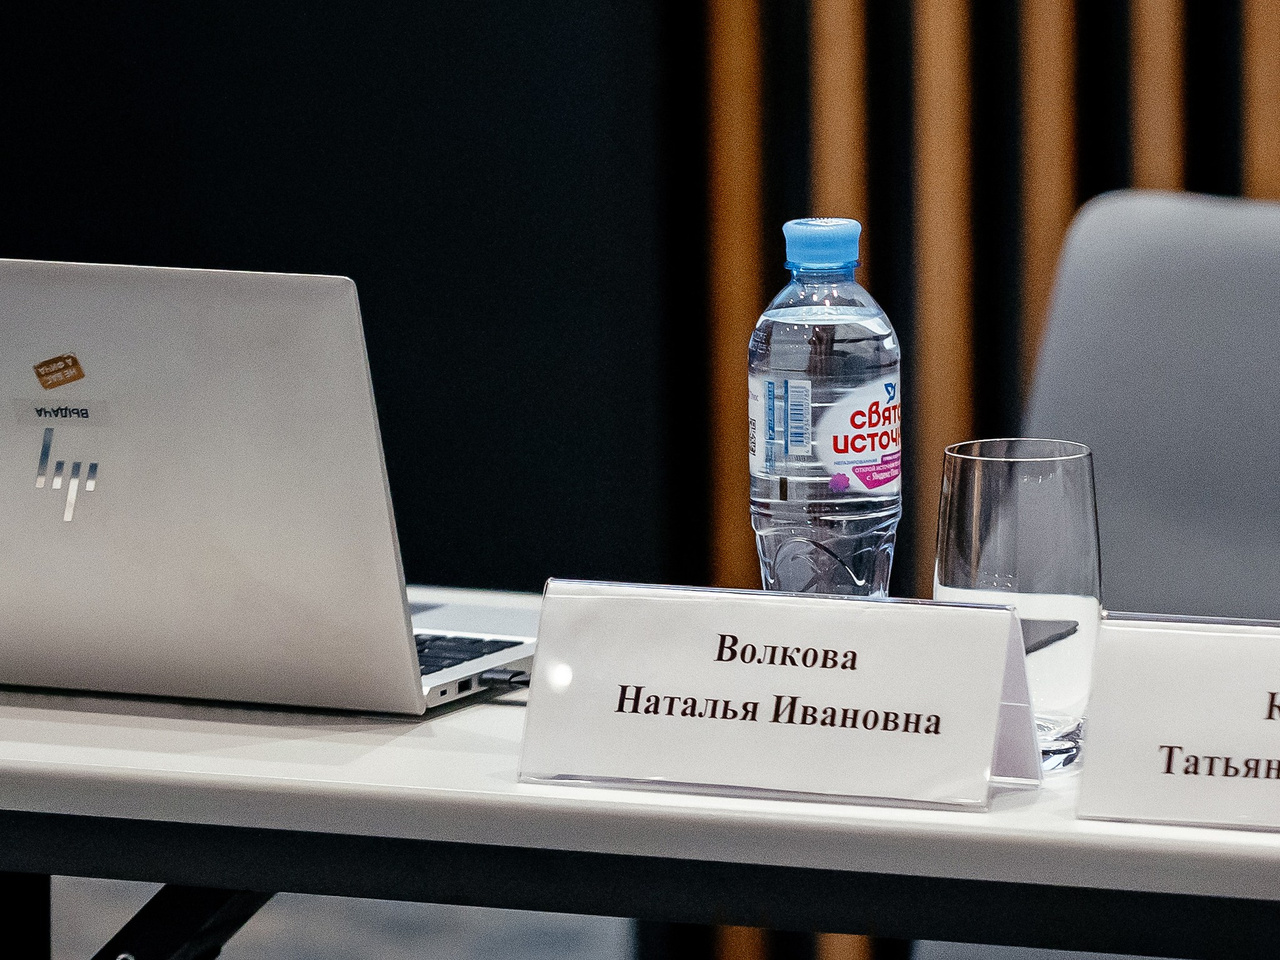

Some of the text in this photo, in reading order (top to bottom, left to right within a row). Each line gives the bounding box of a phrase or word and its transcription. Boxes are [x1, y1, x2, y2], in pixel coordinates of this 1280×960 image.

[35, 406, 89, 418] ВЫДАЧА
[849, 400, 901, 430] СВЯТО
[832, 427, 901, 454] ИСТОЧ
[713, 633, 858, 671] Волкова
[613, 684, 942, 736] Наталья Ивановна
